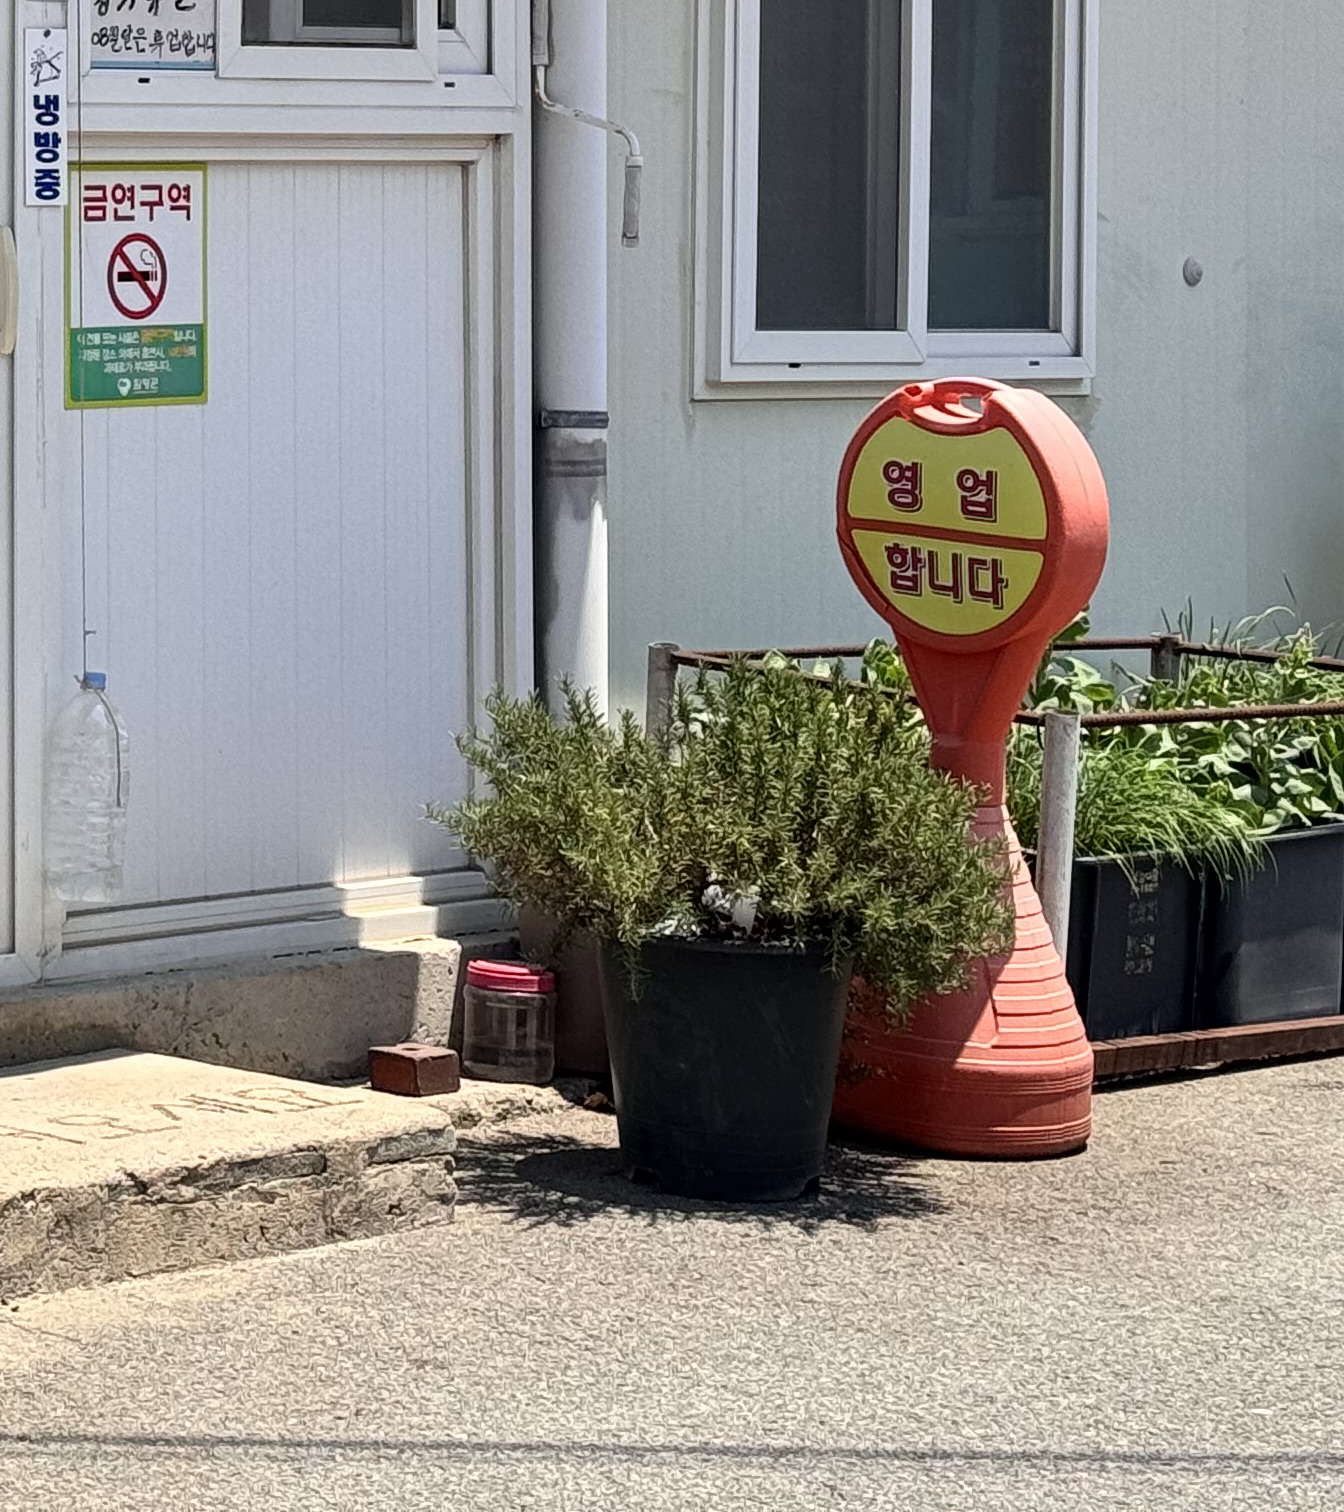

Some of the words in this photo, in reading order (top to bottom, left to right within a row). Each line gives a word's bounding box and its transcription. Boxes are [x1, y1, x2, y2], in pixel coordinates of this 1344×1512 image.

[32, 94, 62, 201] 냉방중
[83, 183, 191, 222] 금연구역
[885, 542, 1009, 610] 합니다
